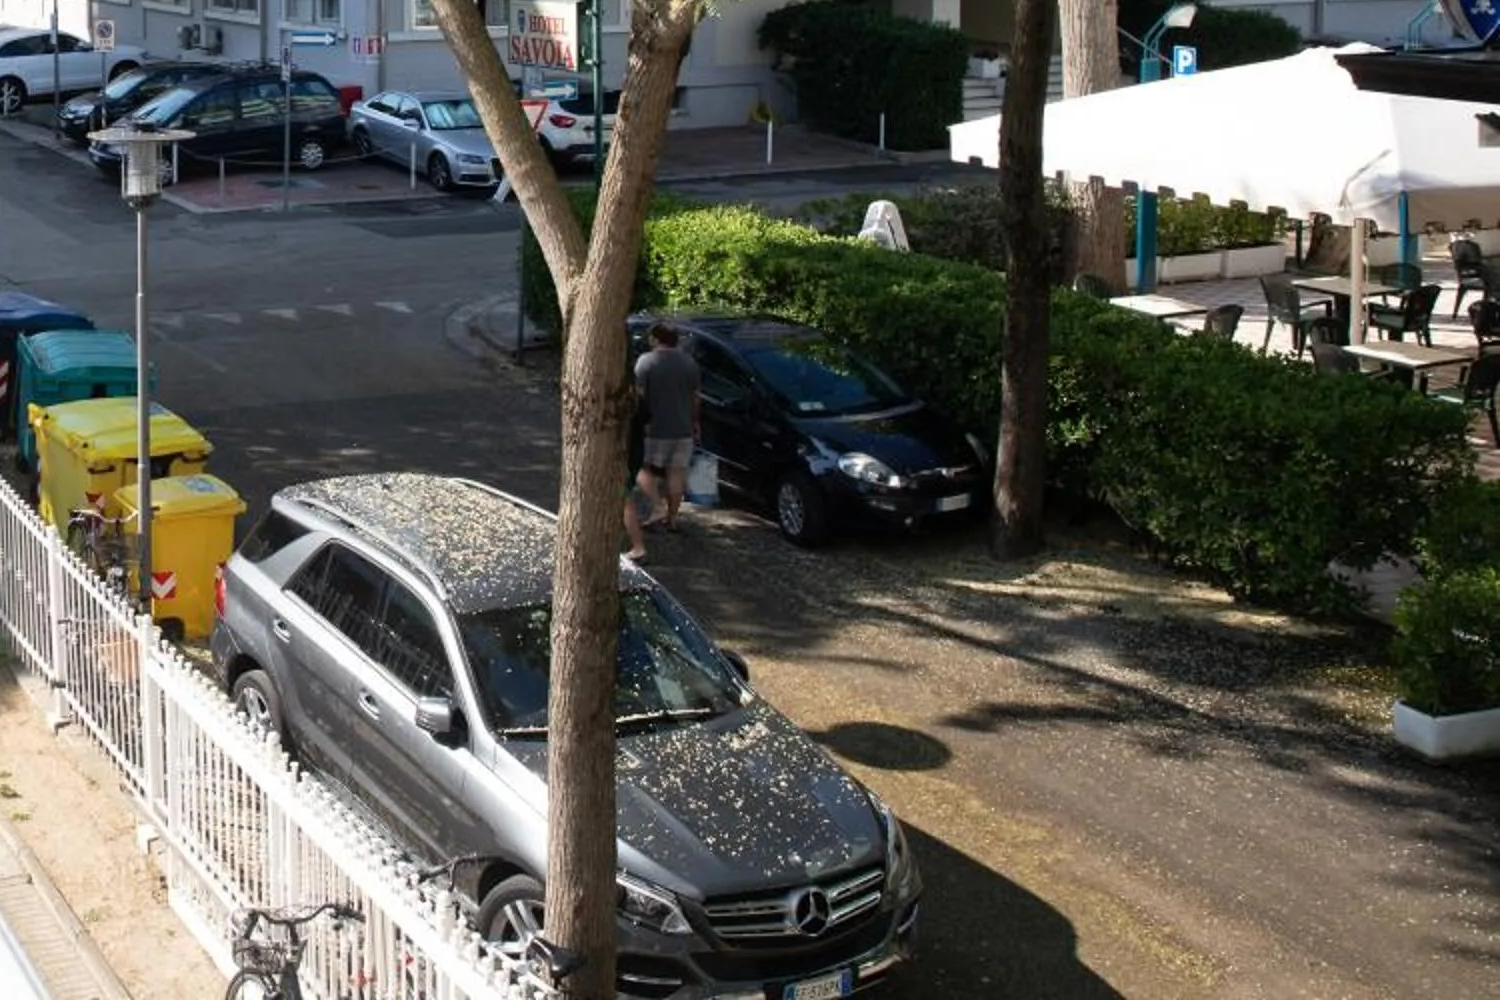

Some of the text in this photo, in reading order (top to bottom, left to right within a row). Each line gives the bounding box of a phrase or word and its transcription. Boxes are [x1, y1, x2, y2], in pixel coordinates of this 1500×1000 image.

[529, 14, 567, 35] HOTEL
[511, 34, 575, 72] SAVOIA
[1177, 49, 1193, 73] P
